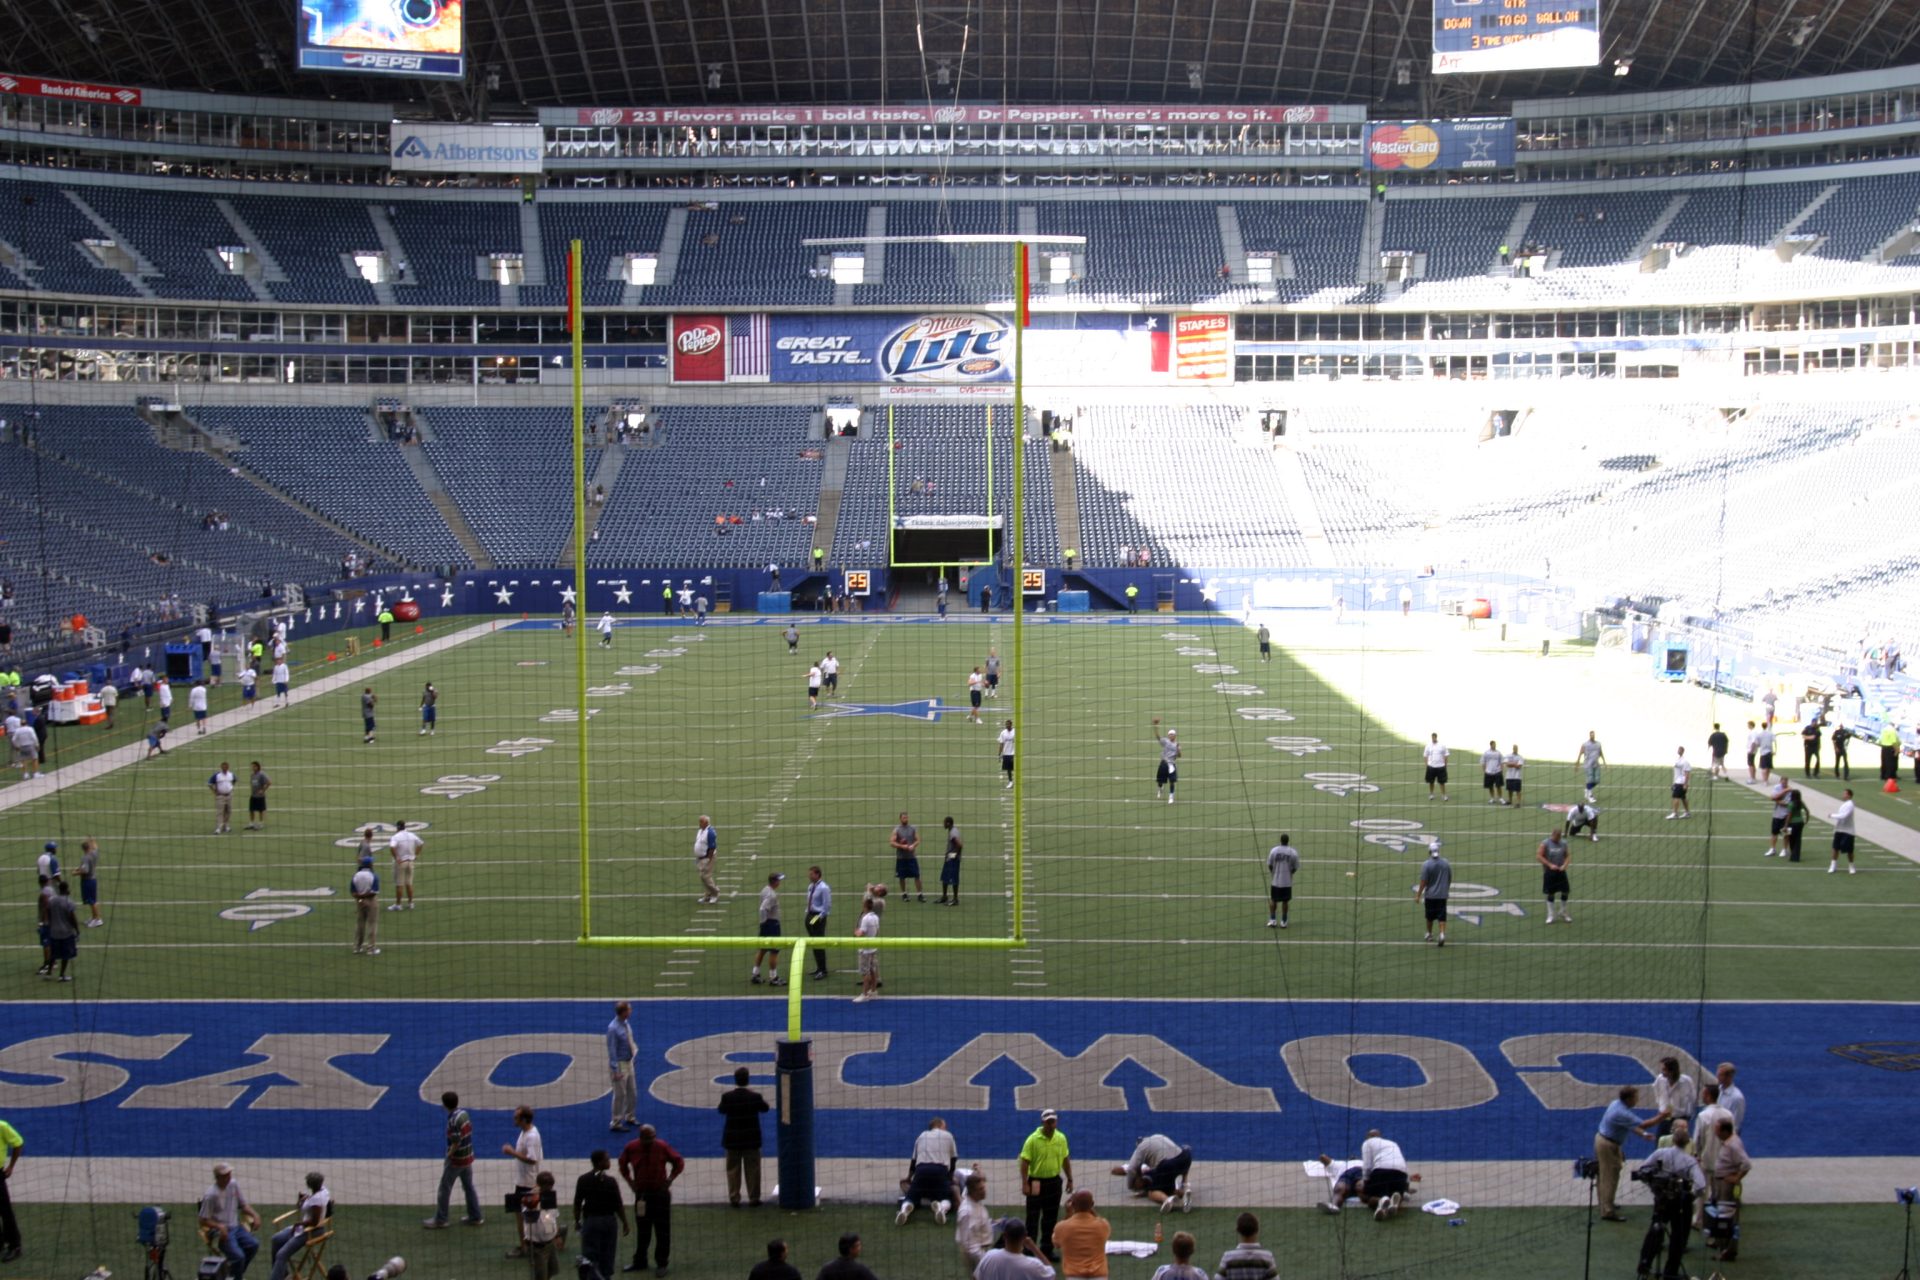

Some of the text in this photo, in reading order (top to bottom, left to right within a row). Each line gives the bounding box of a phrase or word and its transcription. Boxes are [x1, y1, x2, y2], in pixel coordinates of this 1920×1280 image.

[1443, 10, 1580, 30] DOWN TO GO BALL ON
[1471, 35, 1480, 49] 3
[361, 54, 422, 70] PEPSI
[41, 83, 112, 100] Bank of America
[632, 109, 927, 122] 23 Flavors make 1 bold taste.
[978, 108, 1273, 122] Dr Pepper. There's more to it.
[1454, 121, 1506, 131] Official Card
[434, 143, 539, 161] Albertsons
[1371, 140, 1438, 154] MasterCard
[920, 316, 977, 334] Miller
[1178, 317, 1226, 332] STAPLES
[692, 327, 707, 339] Dr
[682, 331, 718, 352] Pepper
[776, 336, 853, 350] GREAT
[790, 351, 872, 365] TASTE...
[890, 328, 1009, 376] Lite
[848, 573, 868, 588] 25
[1023, 572, 1042, 587] 25
[420, 774, 504, 795] 30
[1304, 771, 1382, 793] 30
[1350, 818, 1440, 846] 20
[219, 886, 337, 921] 10
[0, 1031, 1722, 1113] COWBOYS
